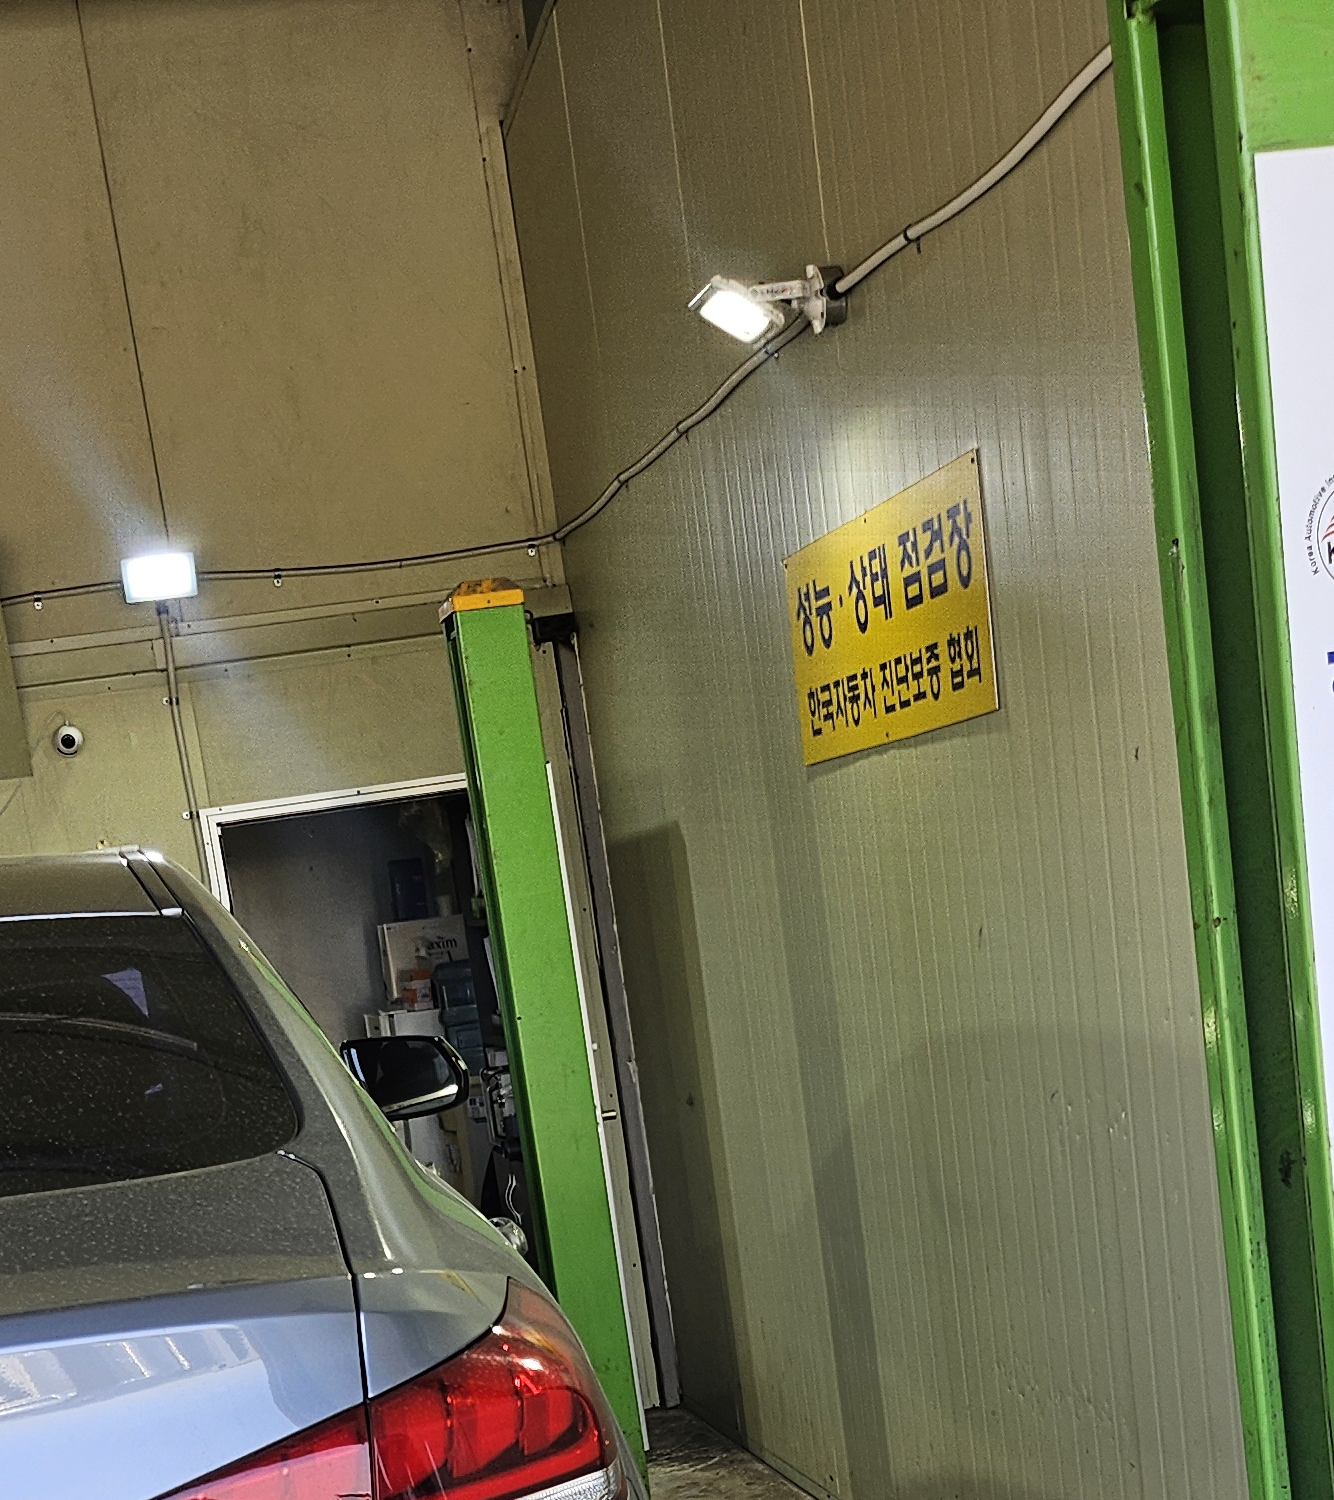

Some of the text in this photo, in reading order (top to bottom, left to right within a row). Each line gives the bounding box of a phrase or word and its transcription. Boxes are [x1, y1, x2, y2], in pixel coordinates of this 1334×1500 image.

[898, 499, 974, 611] 점검장
[1304, 486, 1327, 541] Automotive
[1306, 545, 1320, 576] Korea
[806, 624, 983, 738] 한국자동차 진단보증 협회
